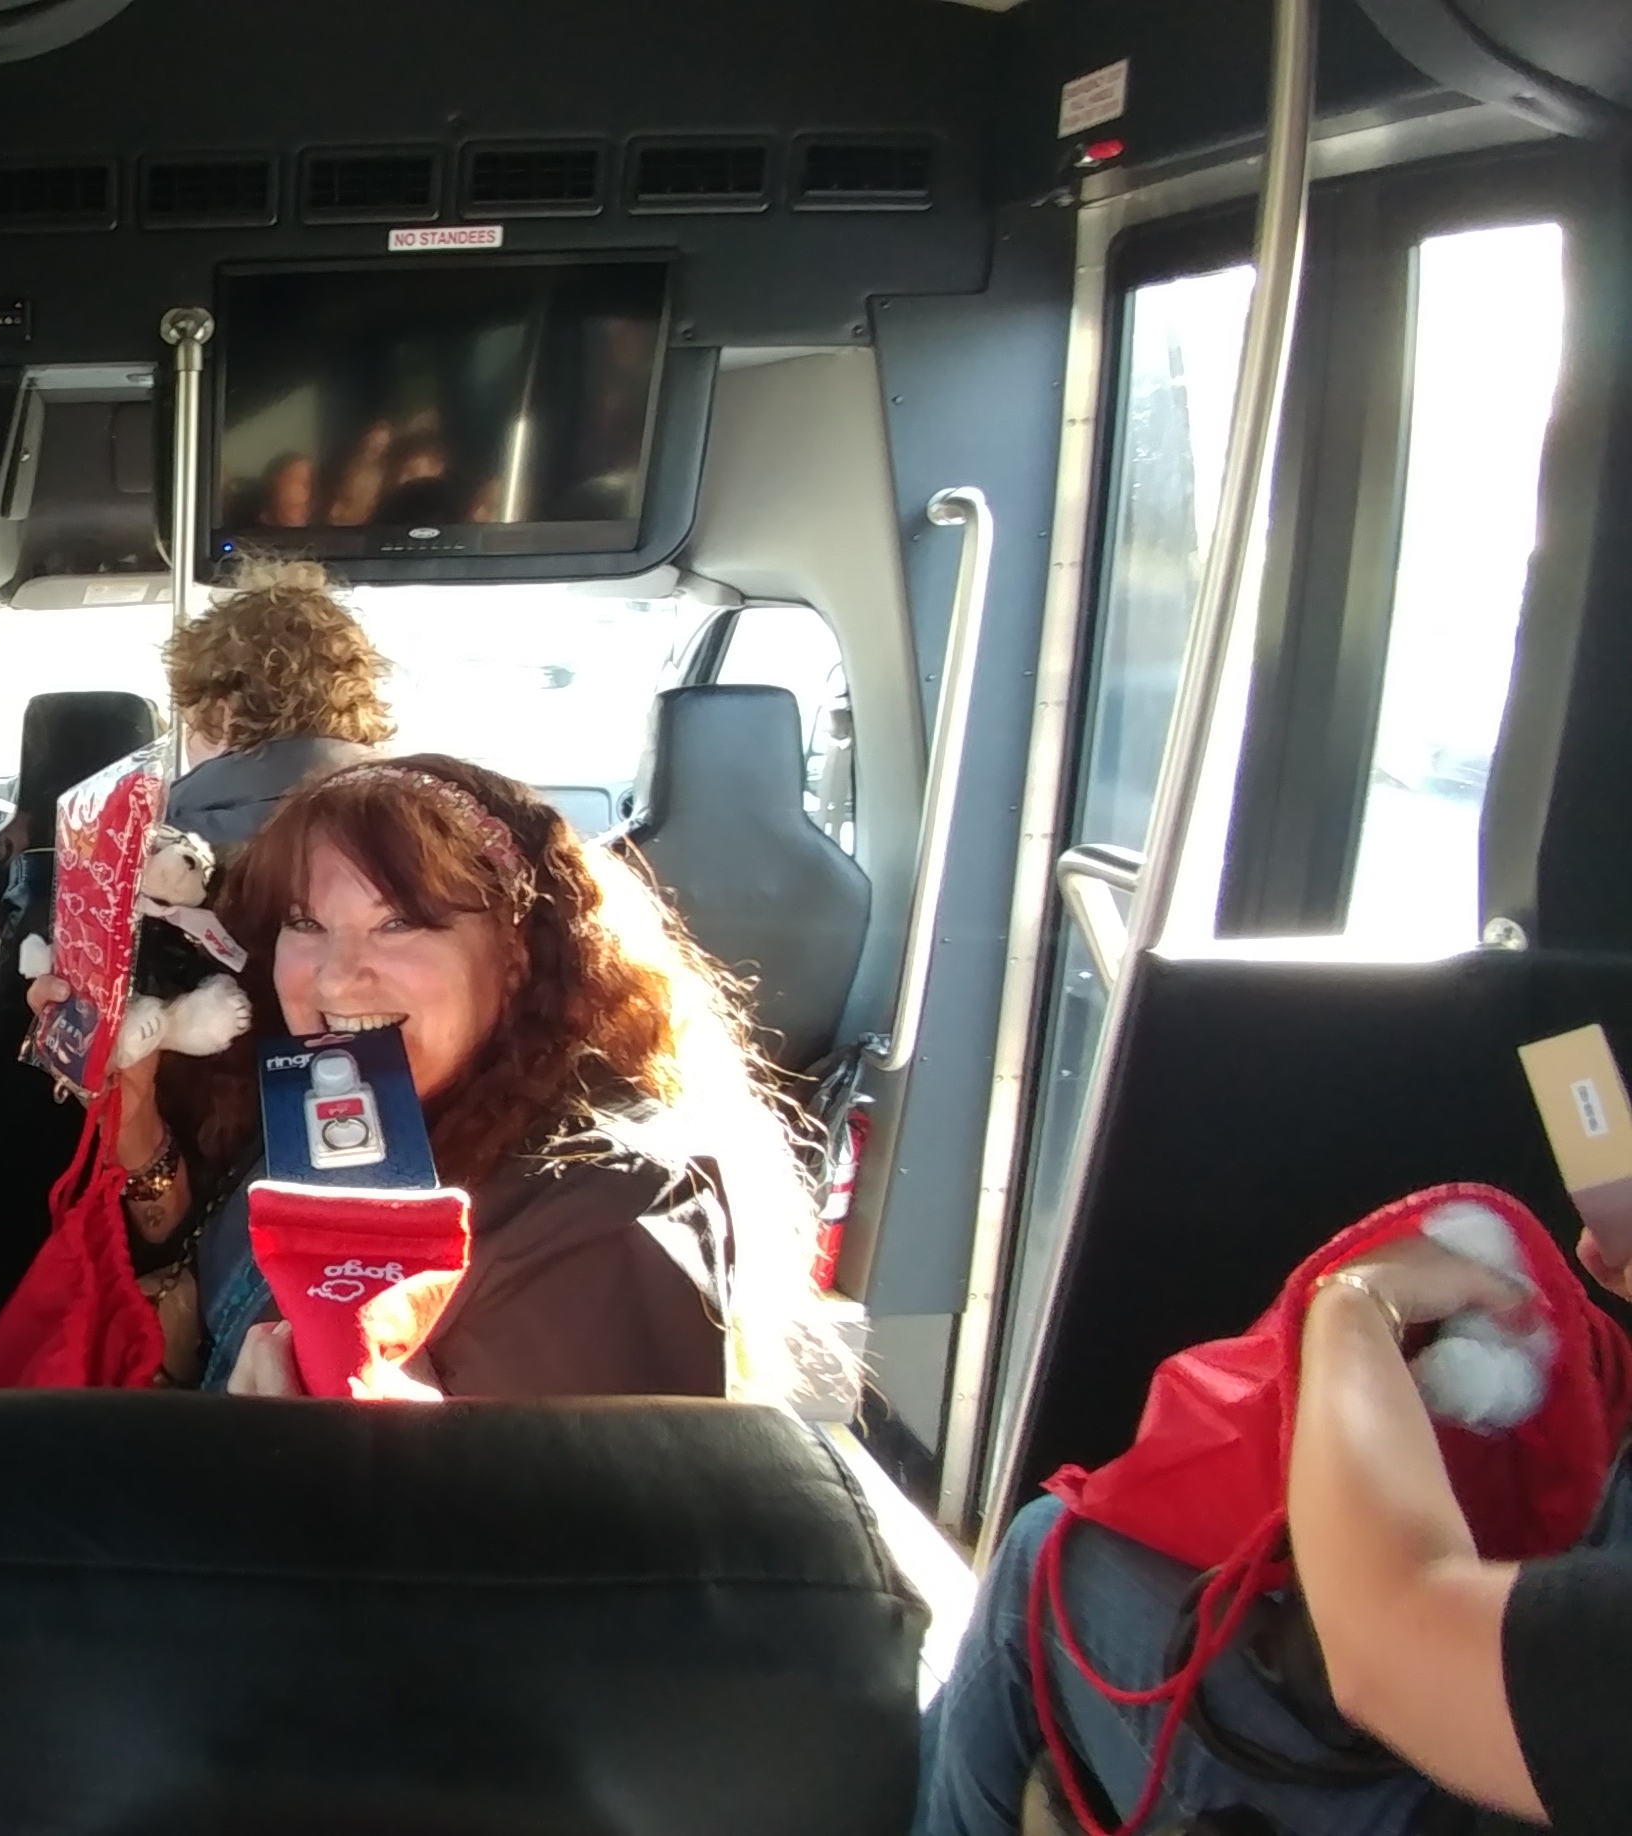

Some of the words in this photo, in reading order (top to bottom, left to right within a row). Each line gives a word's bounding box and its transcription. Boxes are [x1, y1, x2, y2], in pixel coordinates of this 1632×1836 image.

[394, 233, 416, 247] NO
[419, 230, 496, 246] STANDEES
[323, 1259, 405, 1284] gogo
